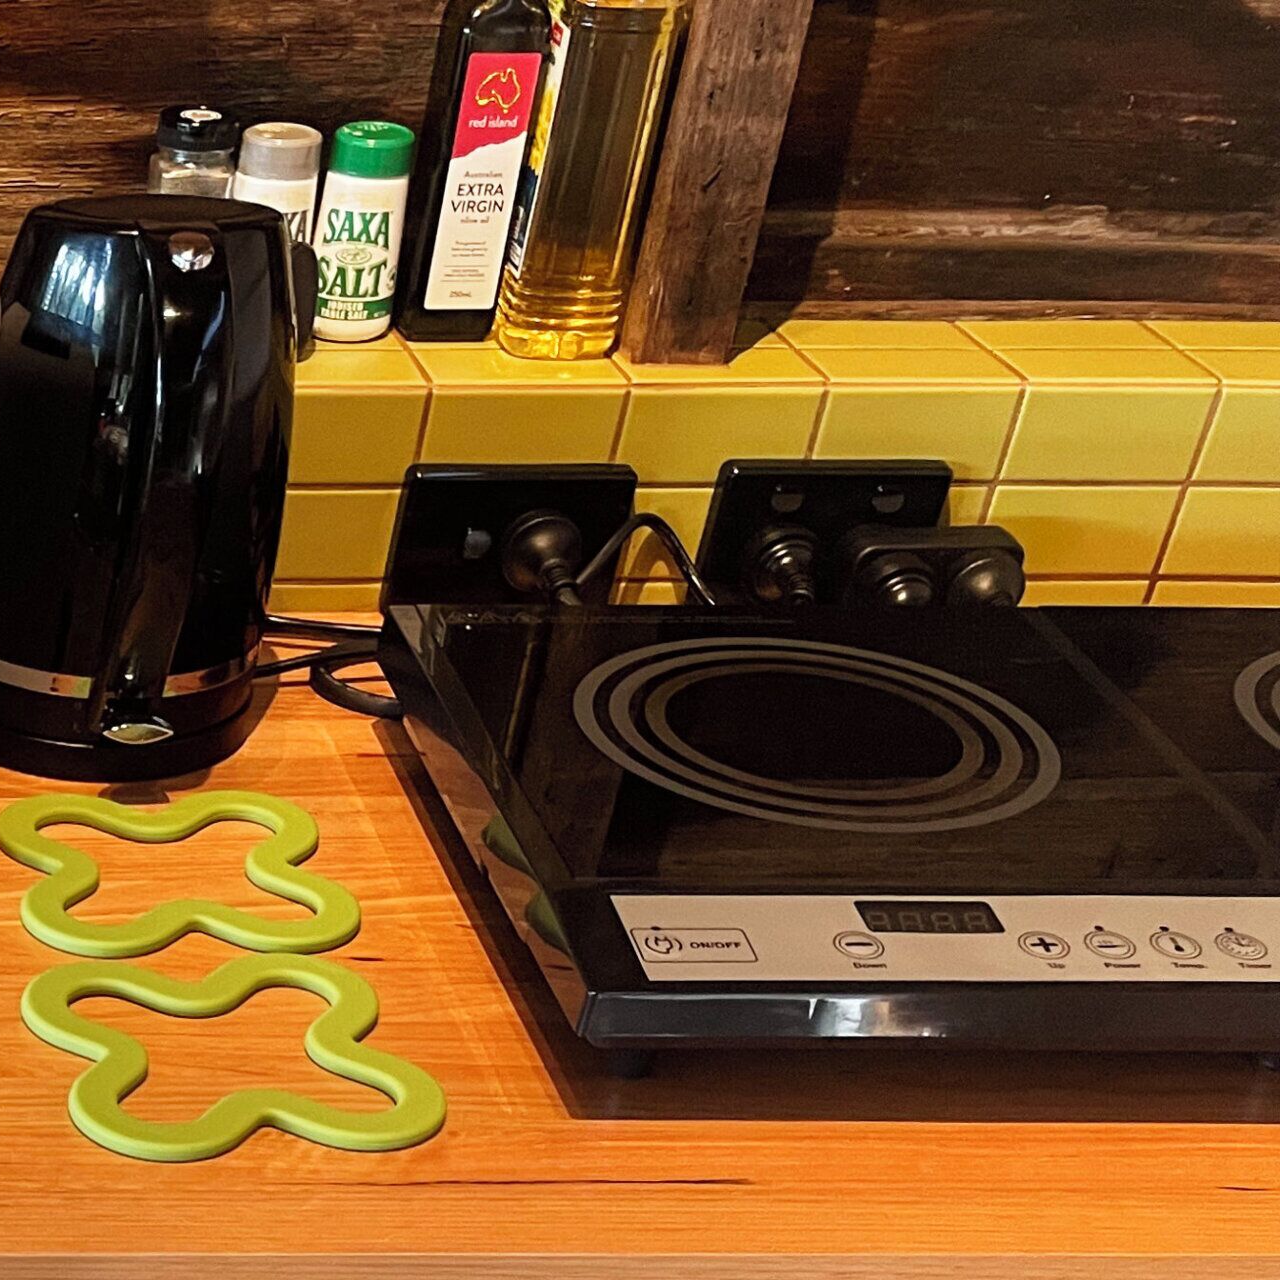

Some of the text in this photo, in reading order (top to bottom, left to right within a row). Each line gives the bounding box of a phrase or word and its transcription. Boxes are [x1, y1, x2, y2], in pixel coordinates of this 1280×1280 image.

[469, 116, 519, 128] red island
[457, 184, 504, 197] EXTRA
[451, 200, 504, 213] VIRGIN
[323, 208, 390, 248] SAXA
[319, 255, 387, 298] SALT
[348, 310, 368, 319] SALT
[853, 961, 887, 969] Down
[1048, 962, 1065, 970] Up
